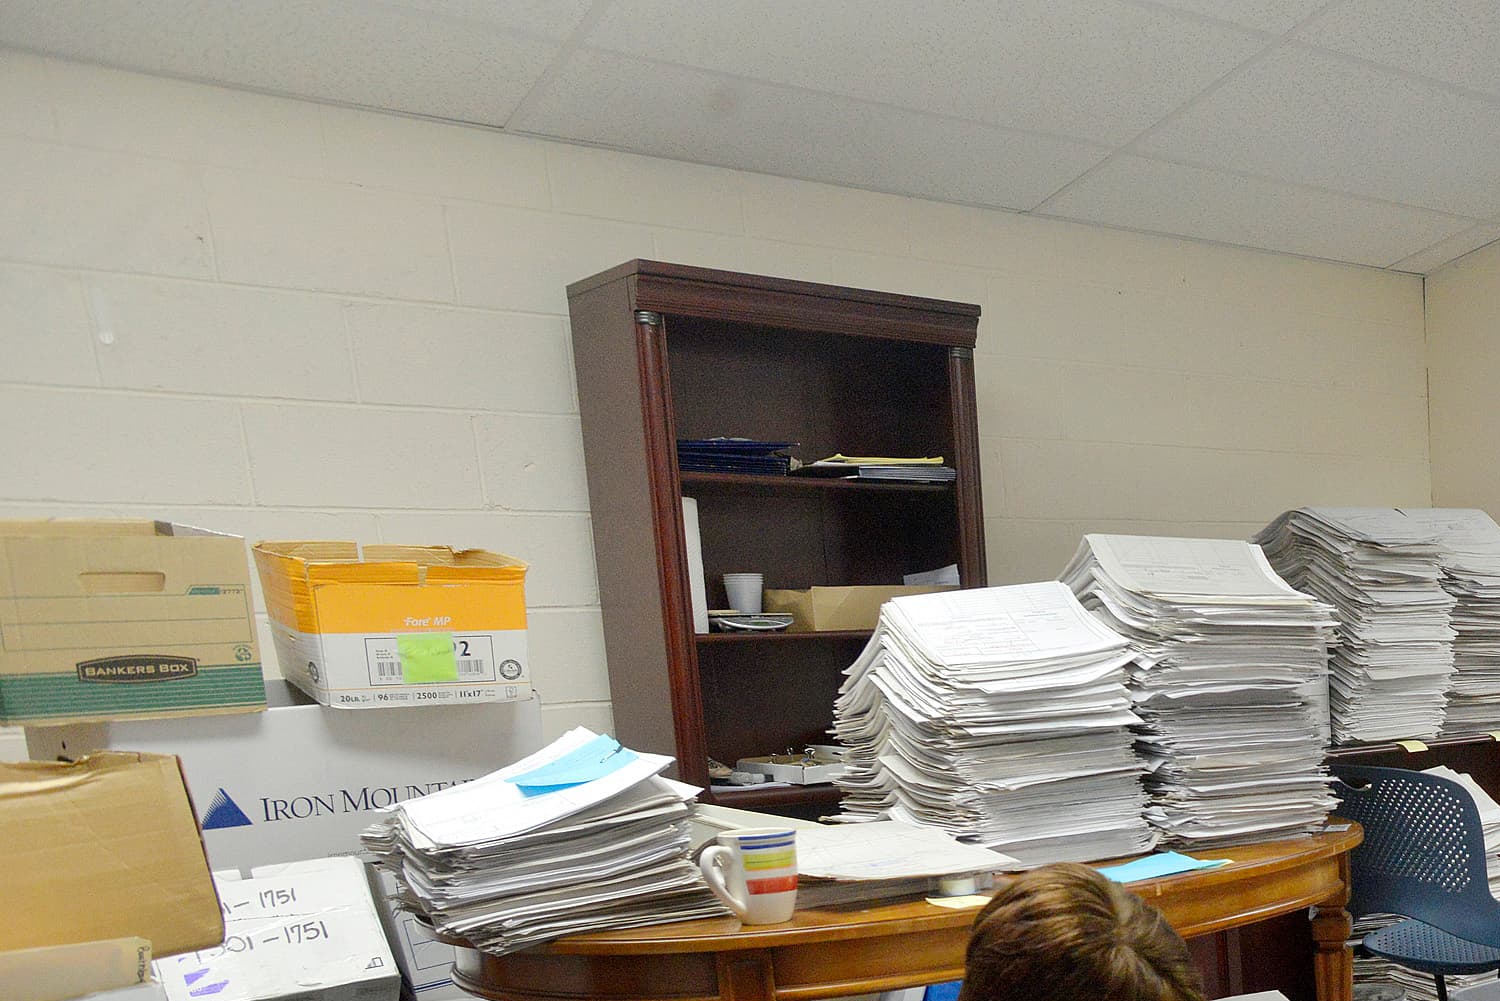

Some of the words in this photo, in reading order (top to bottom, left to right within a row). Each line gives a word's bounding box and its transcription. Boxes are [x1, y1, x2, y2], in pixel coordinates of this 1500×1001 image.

[433, 616, 452, 626] MP
[85, 663, 156, 677] BANKERS
[159, 663, 190, 673] BOX
[260, 794, 336, 823] IRON
[258, 888, 297, 909] 1751
[284, 920, 329, 944] 1751
